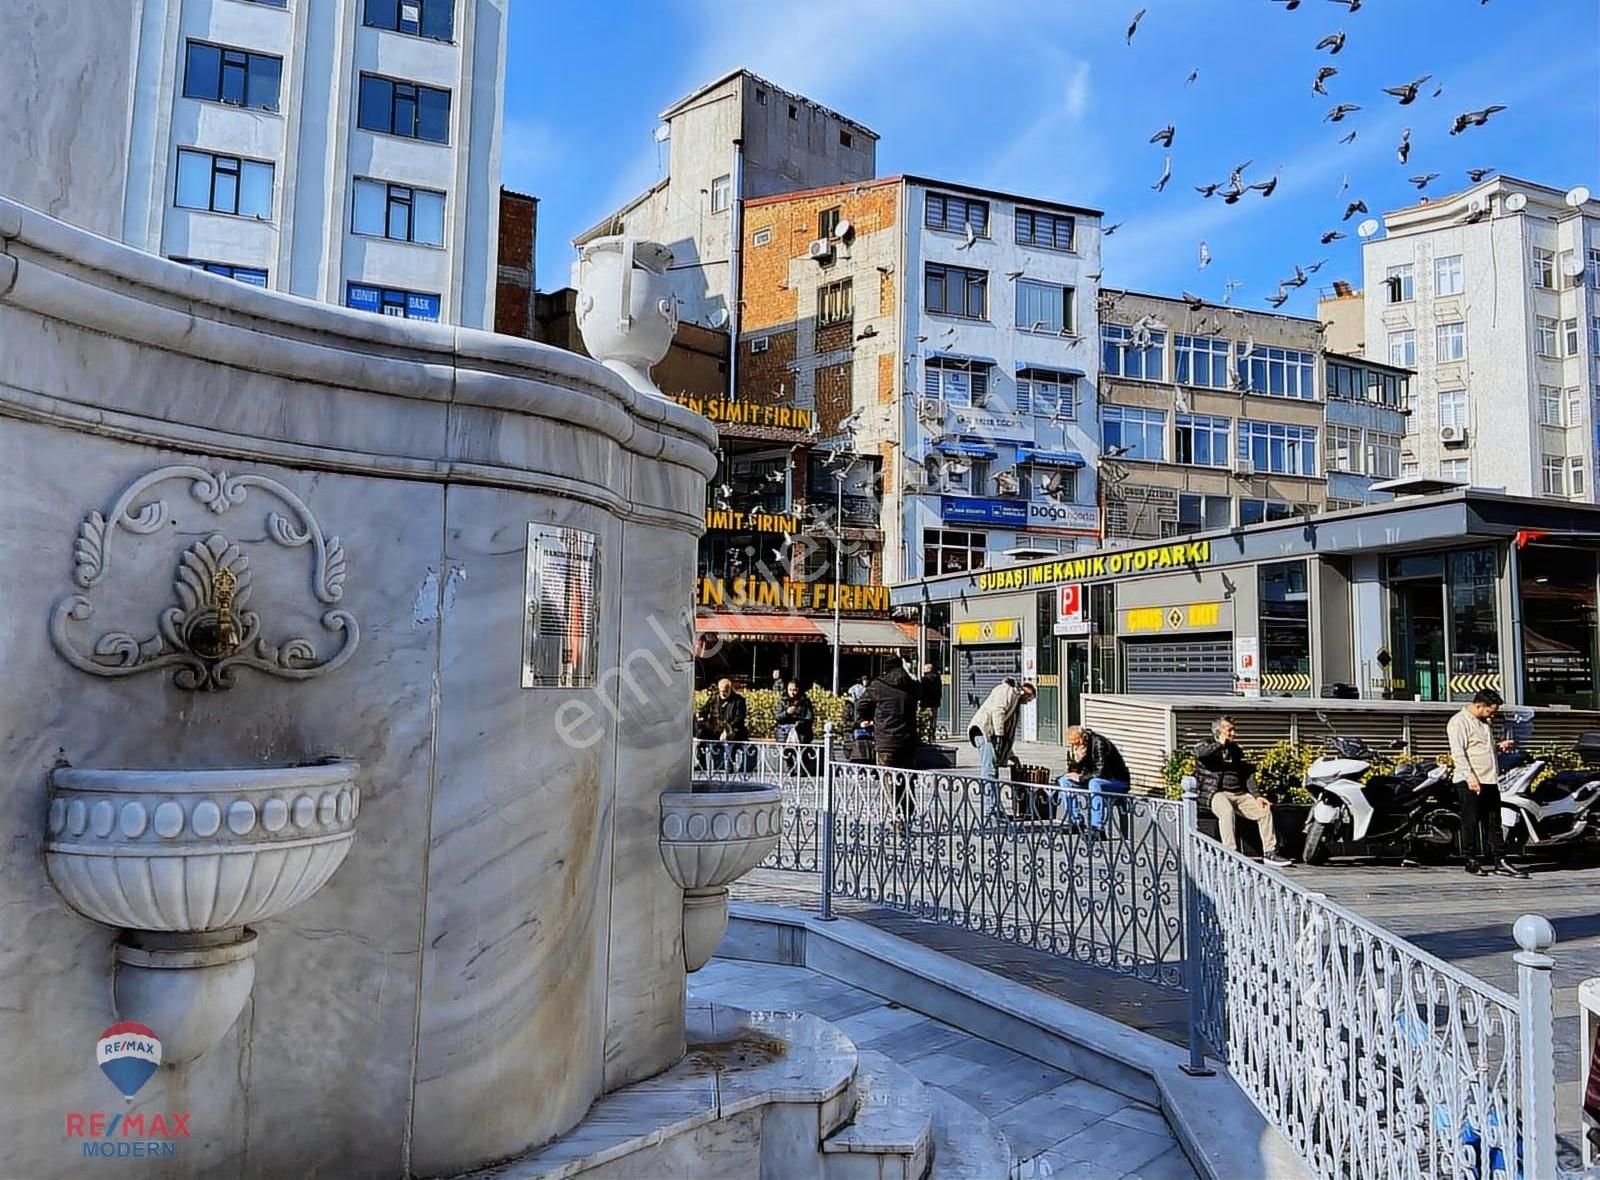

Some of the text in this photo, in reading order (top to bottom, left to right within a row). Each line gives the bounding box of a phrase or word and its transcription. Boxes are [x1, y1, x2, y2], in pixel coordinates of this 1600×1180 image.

[707, 398, 760, 424] SİMİT
[733, 574, 806, 608] SİMİT
[979, 568, 1030, 590] SUBAŞI
